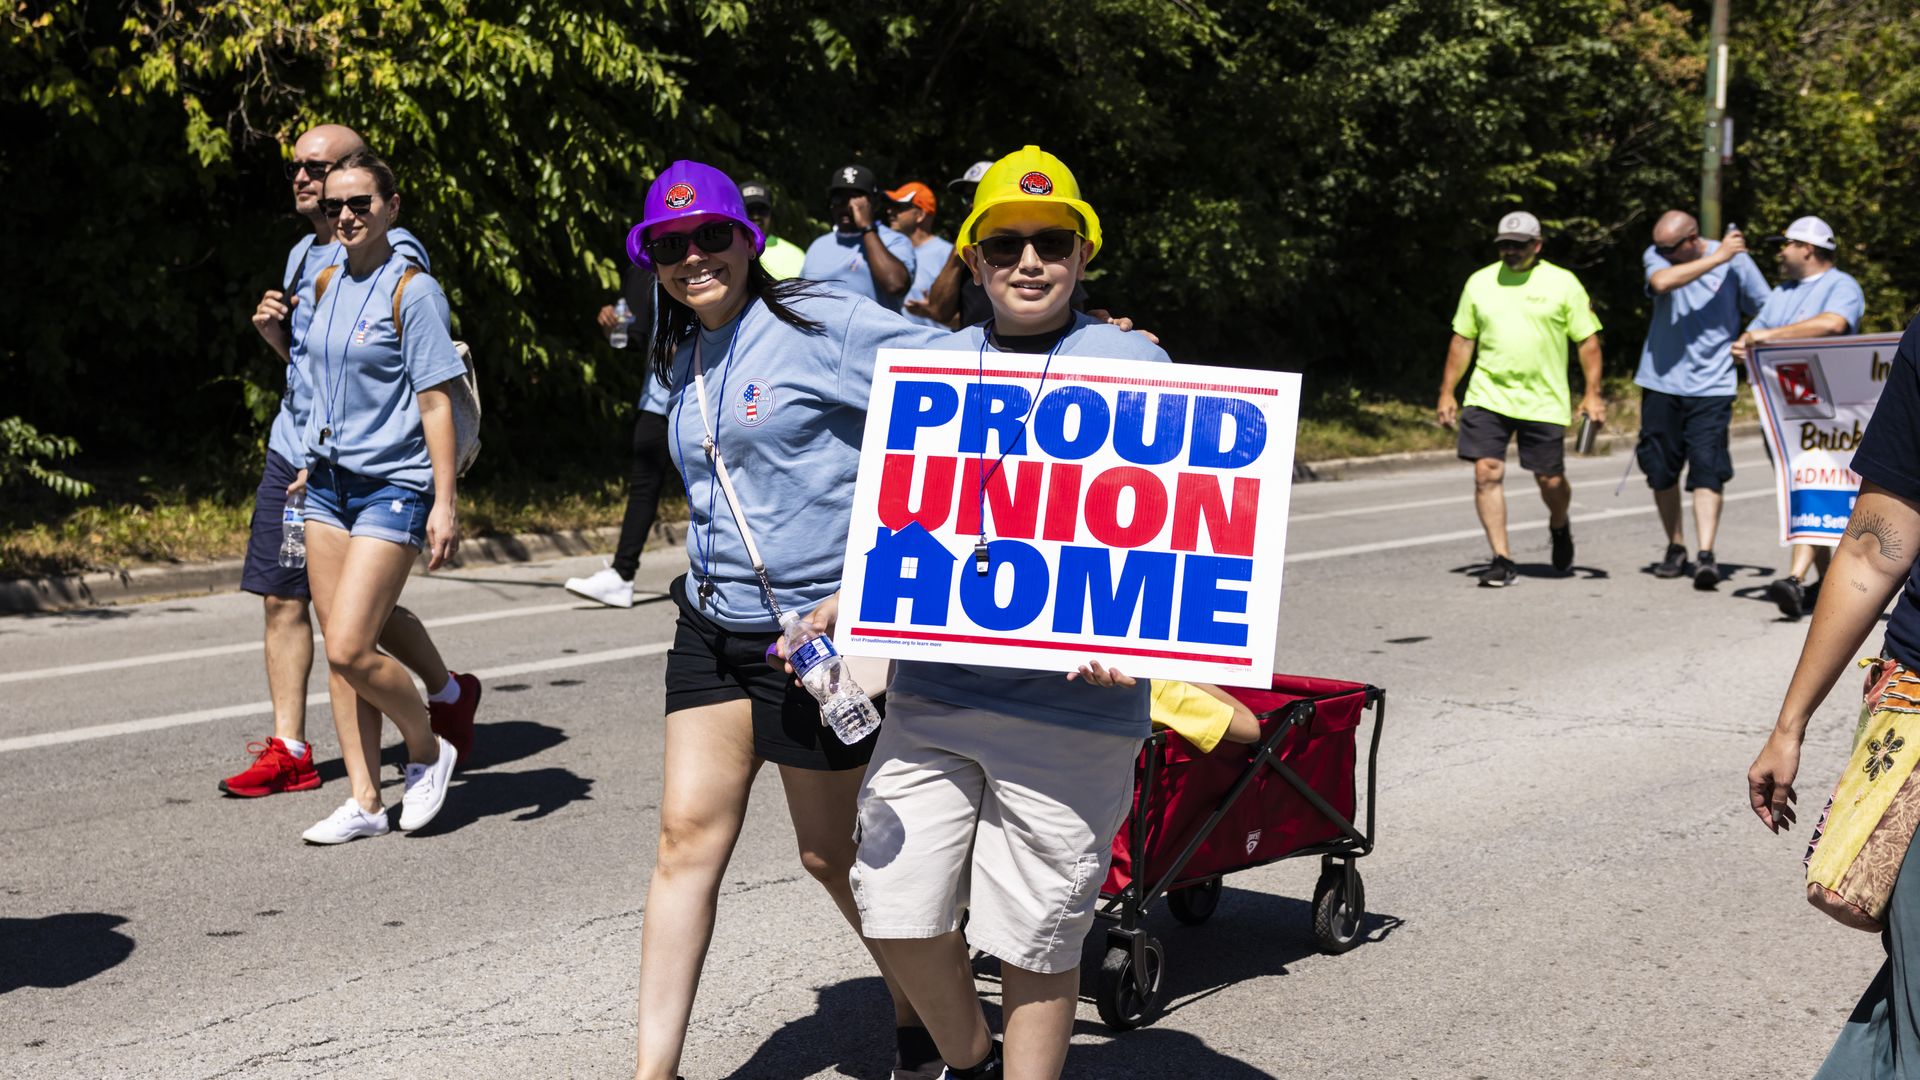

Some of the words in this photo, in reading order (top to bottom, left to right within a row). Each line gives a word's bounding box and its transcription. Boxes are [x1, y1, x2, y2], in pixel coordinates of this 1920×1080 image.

[1871, 351, 1891, 382] In
[886, 380, 1267, 469] PROUD
[1800, 419, 1863, 451] Brick
[877, 453, 1261, 556] UNION
[1794, 468, 1859, 485] ADMIN
[859, 521, 1253, 647] HOME
